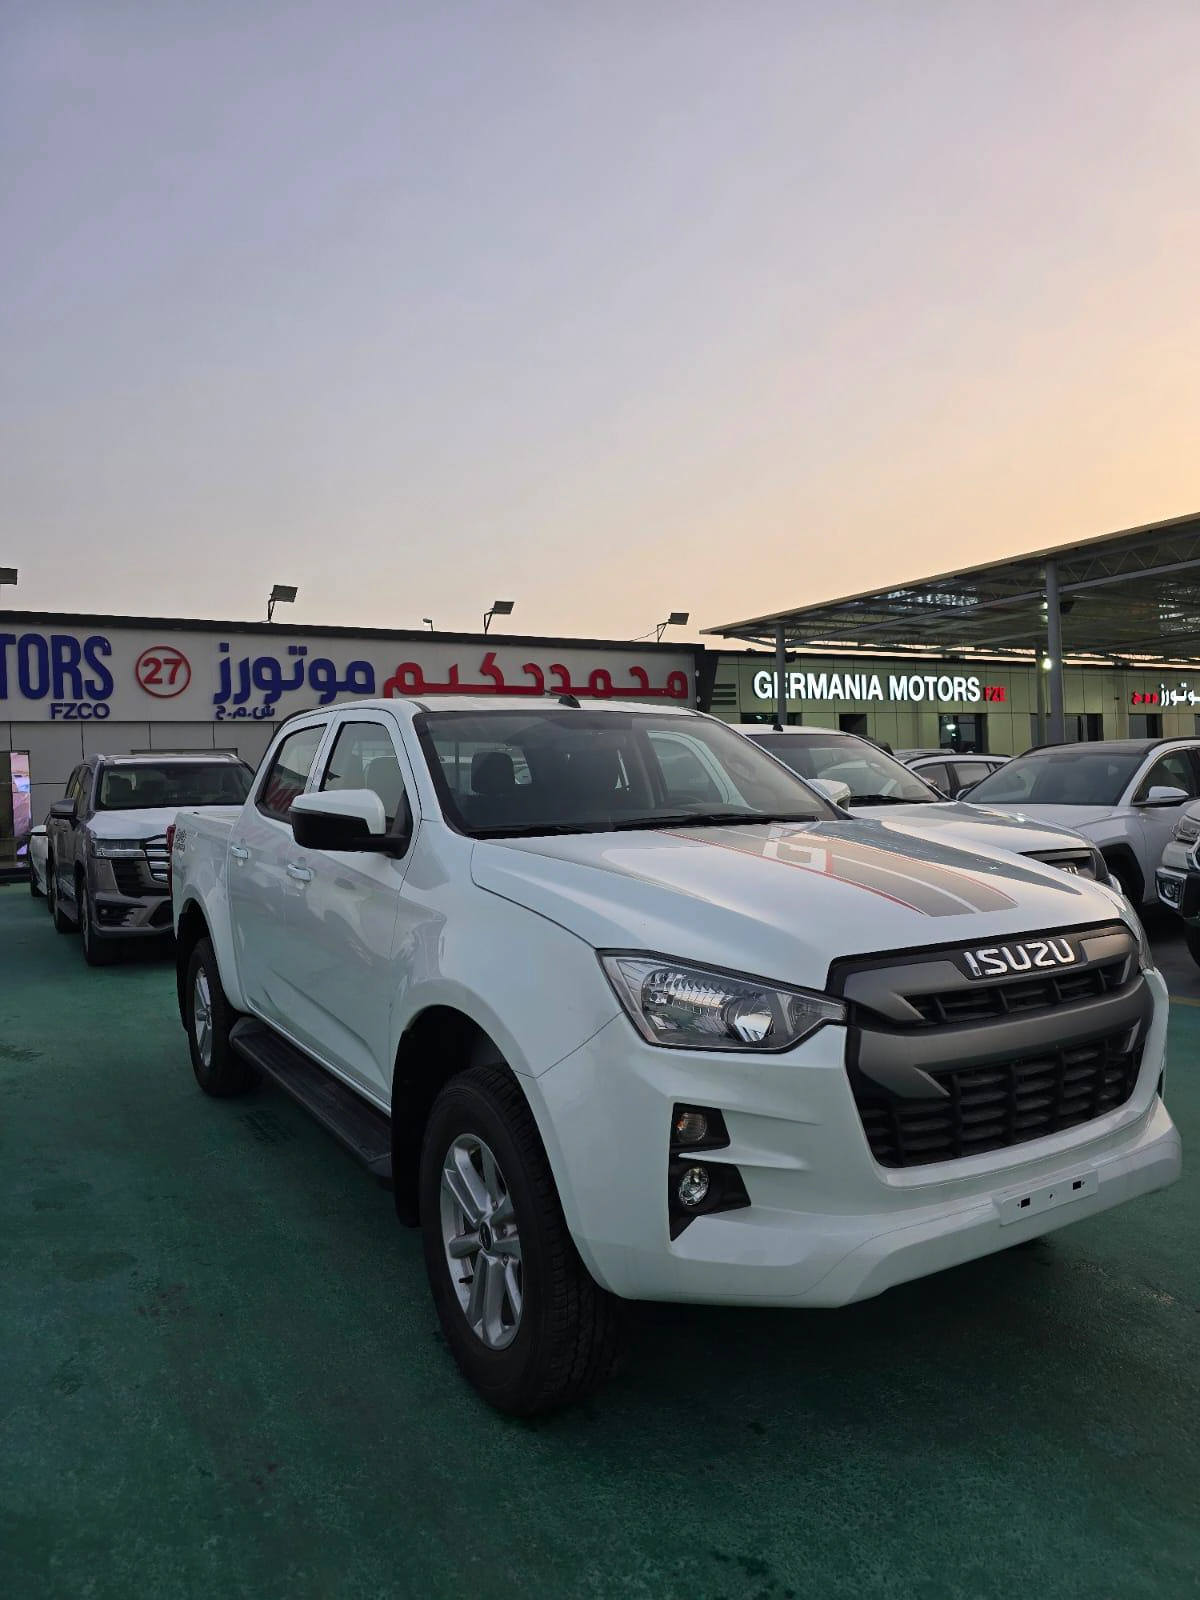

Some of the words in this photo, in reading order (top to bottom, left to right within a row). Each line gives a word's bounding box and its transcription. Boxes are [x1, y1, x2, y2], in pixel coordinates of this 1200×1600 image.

[142, 657, 184, 686] 27
[213, 642, 375, 705] موتورز
[753, 670, 883, 701] GERMANIA
[889, 674, 981, 702] MOTORS
[1160, 682, 1200, 706] وتورز
[50, 702, 111, 720] FZCO
[963, 939, 1075, 977] ISUZU
